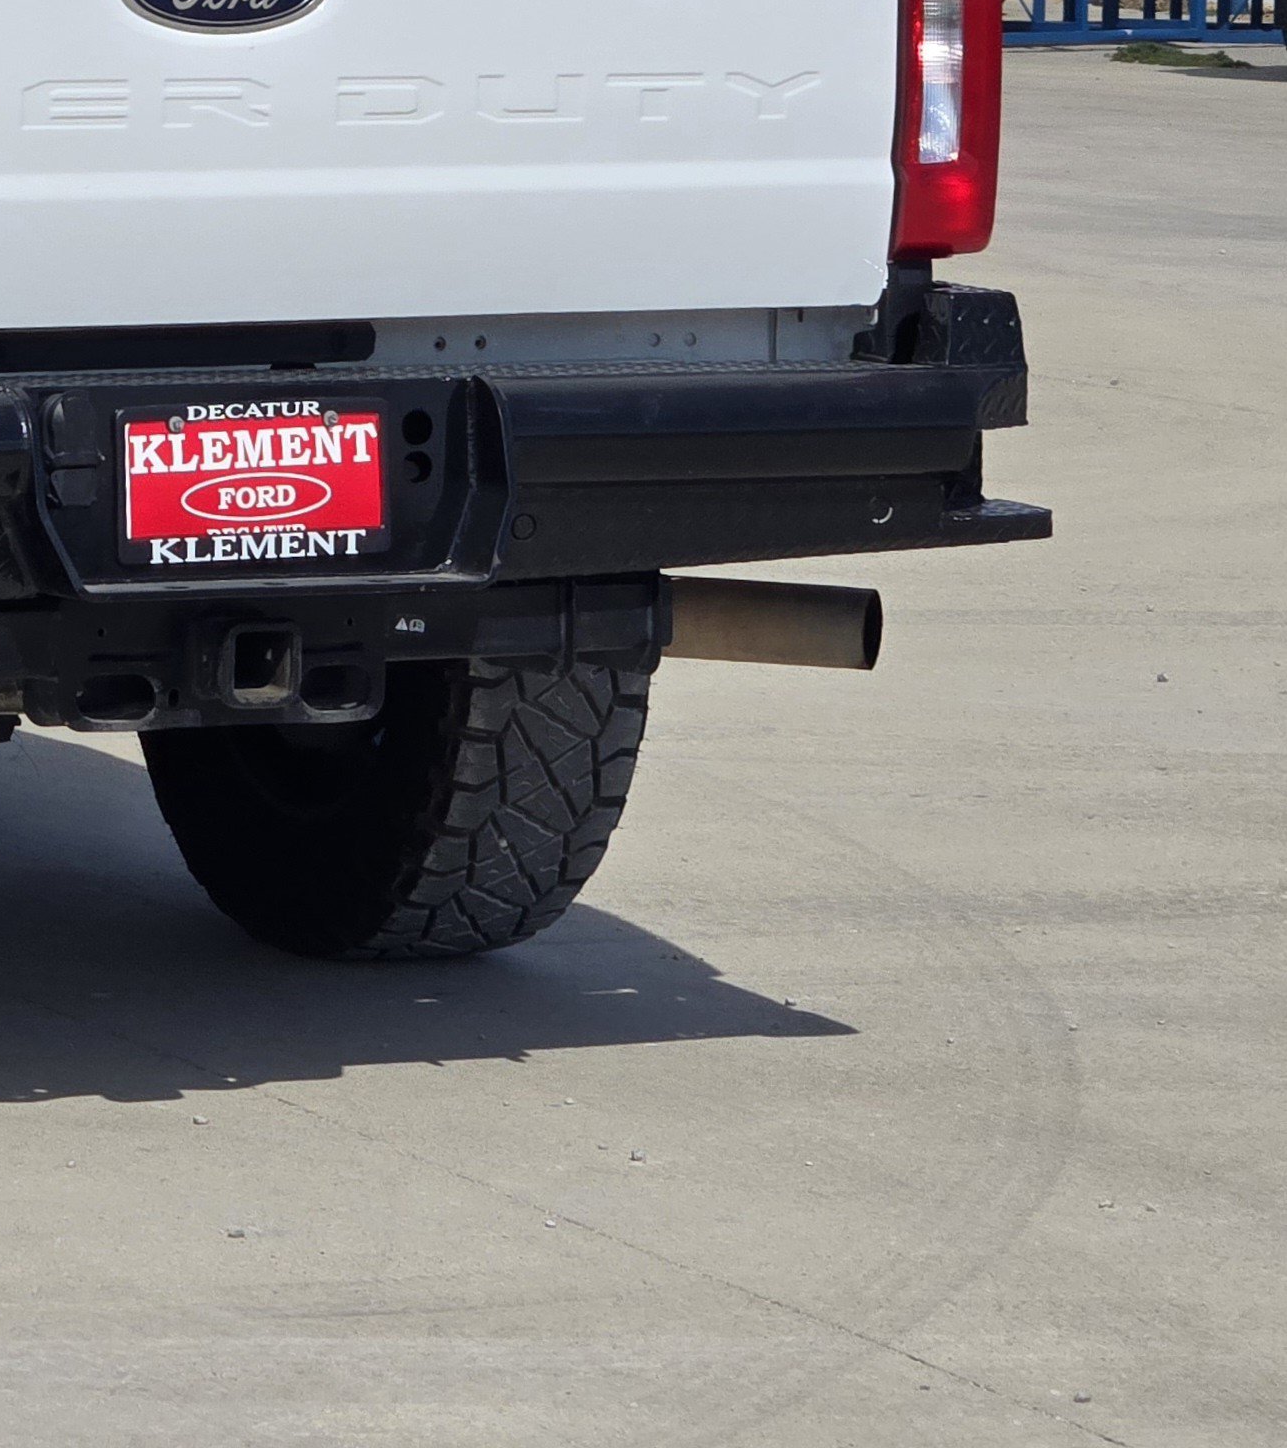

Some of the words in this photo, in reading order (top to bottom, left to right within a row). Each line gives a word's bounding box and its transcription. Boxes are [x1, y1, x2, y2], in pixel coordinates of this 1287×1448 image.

[336, 71, 821, 125] DUTY
[187, 400, 321, 422] DECATUR
[129, 423, 378, 475] KLEMENT
[218, 485, 296, 510] FORD
[150, 530, 366, 565] KLEMENT
